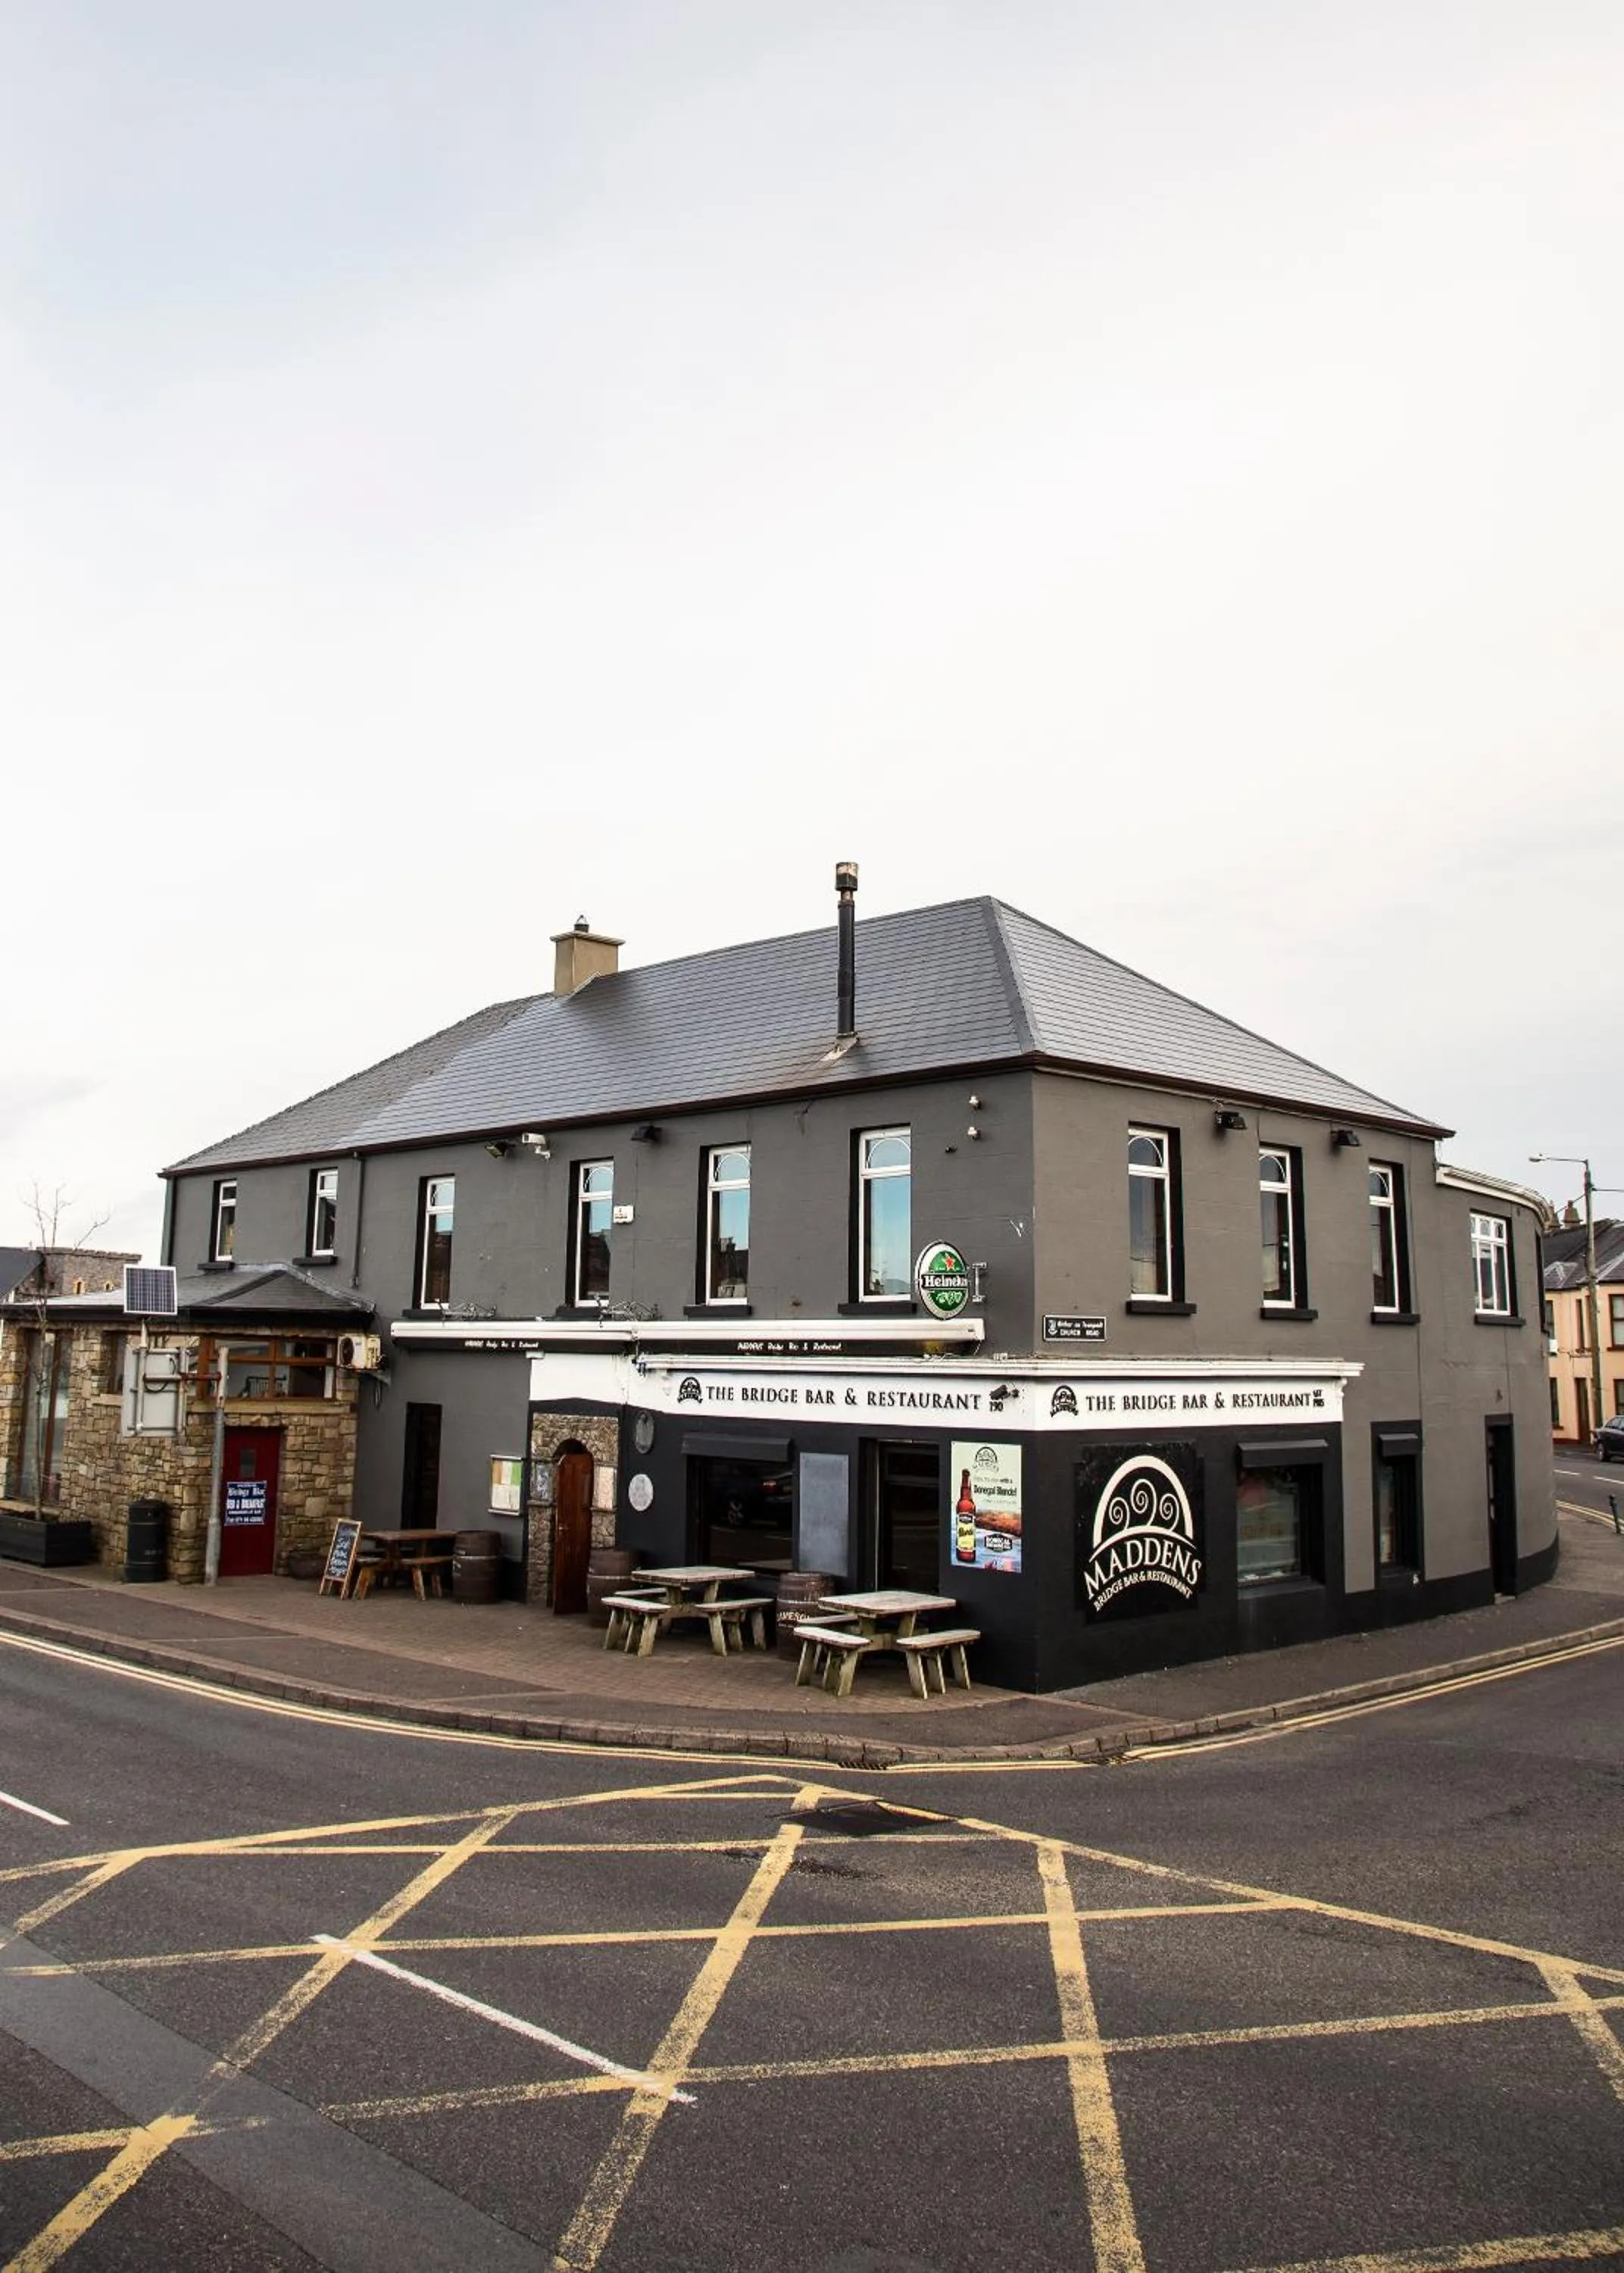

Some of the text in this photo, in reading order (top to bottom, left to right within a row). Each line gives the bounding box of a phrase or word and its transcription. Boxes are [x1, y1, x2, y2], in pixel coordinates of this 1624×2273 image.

[706, 1386, 982, 1410] THE BRIDGE BAR & RESTAURANT
[1085, 1392, 1311, 1412] THE BRIDGE BAR & RESTAURANT
[1084, 1537, 1202, 1600] MADDENS
[1093, 1570, 1194, 1612] BRIDGE BAR & RESTAURANT
